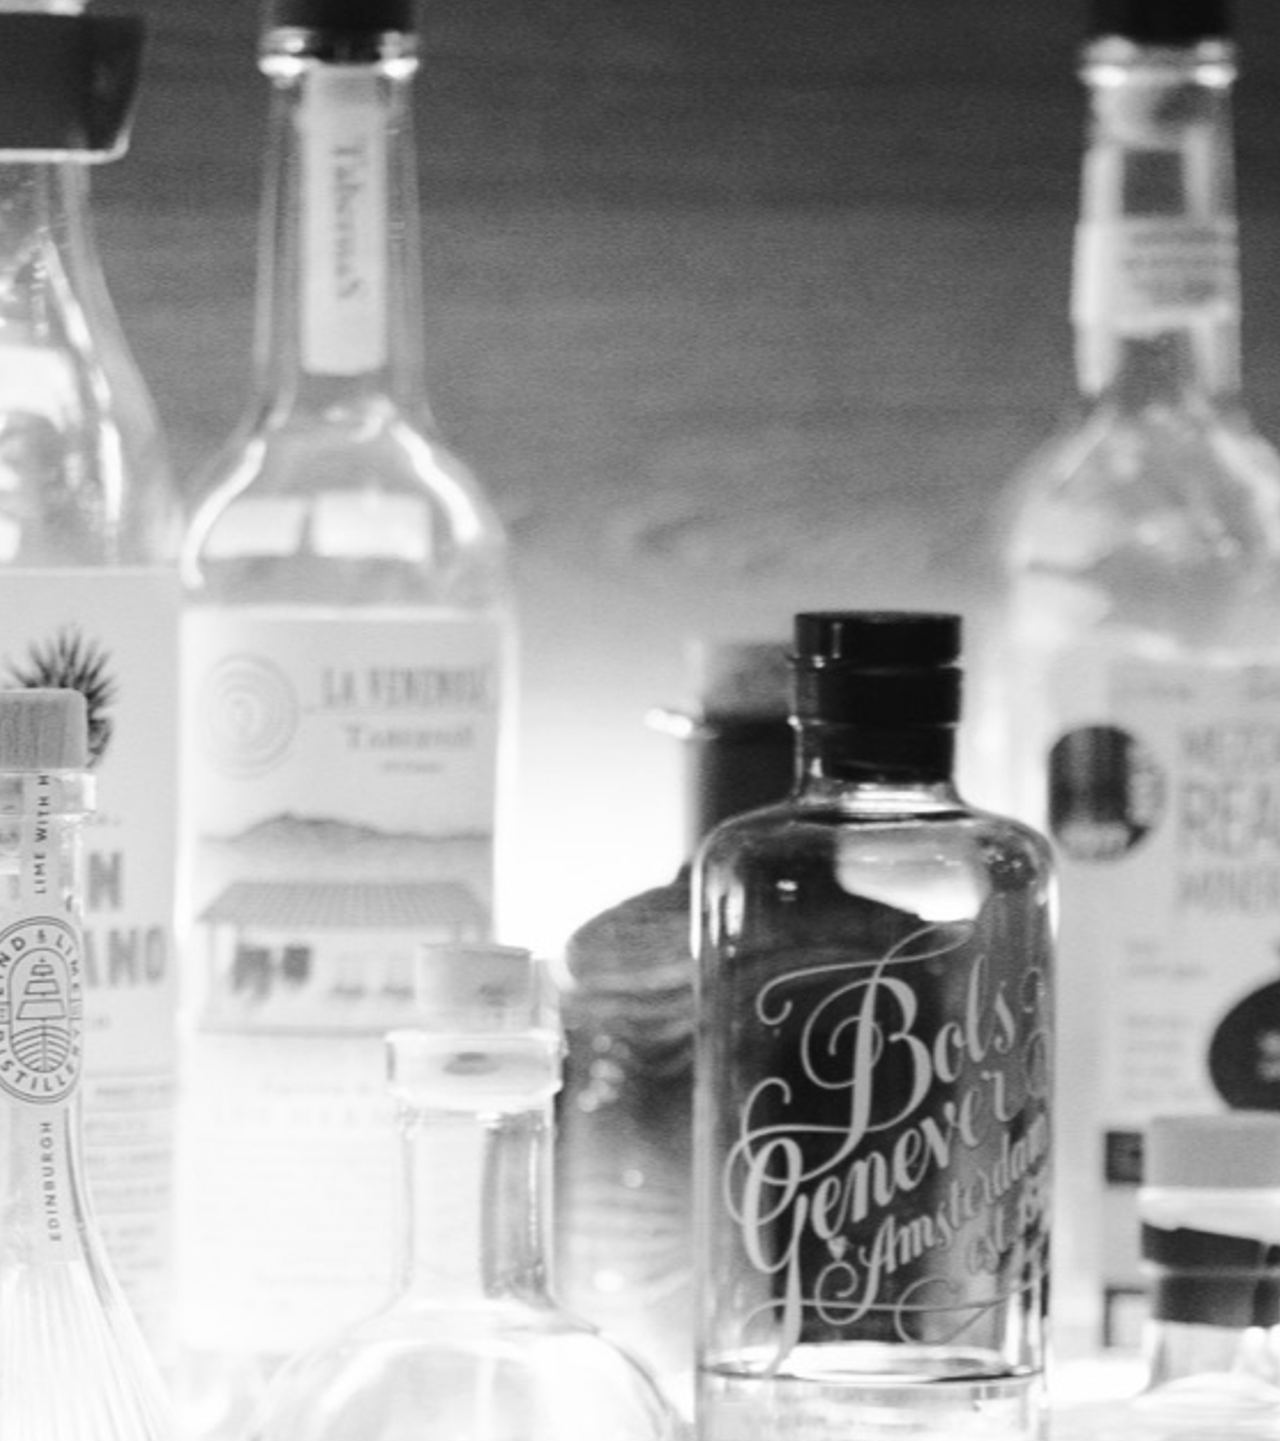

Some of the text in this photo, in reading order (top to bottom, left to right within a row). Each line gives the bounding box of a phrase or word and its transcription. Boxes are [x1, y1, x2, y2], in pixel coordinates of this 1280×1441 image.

[762, 932, 1016, 1172] Bols
[39, 1121, 62, 1242] EDINBURGH
[724, 1070, 1012, 1345] Genever
